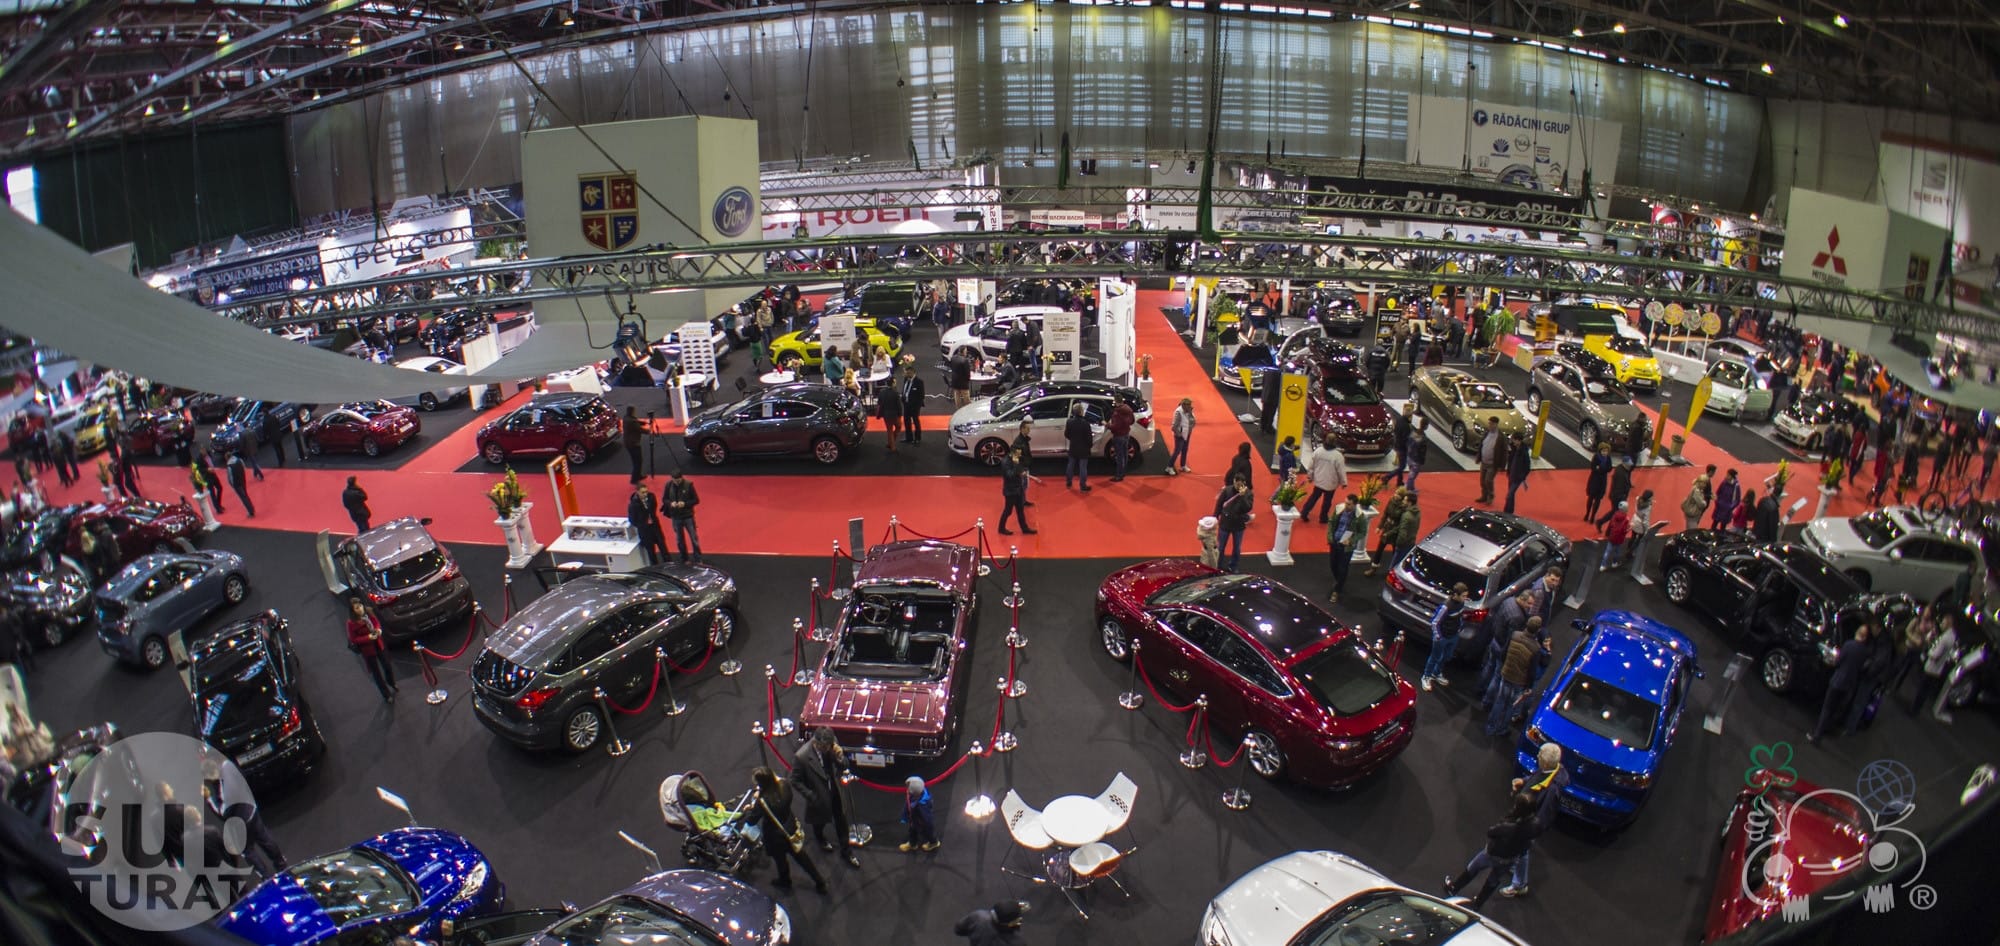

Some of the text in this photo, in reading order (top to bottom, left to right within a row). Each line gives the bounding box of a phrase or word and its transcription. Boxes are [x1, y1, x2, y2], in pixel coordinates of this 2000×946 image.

[1544, 121, 1571, 134] GRUP
[722, 196, 749, 229] Ford
[1516, 202, 1561, 225] OPEL
[267, 280, 283, 293] 2014
